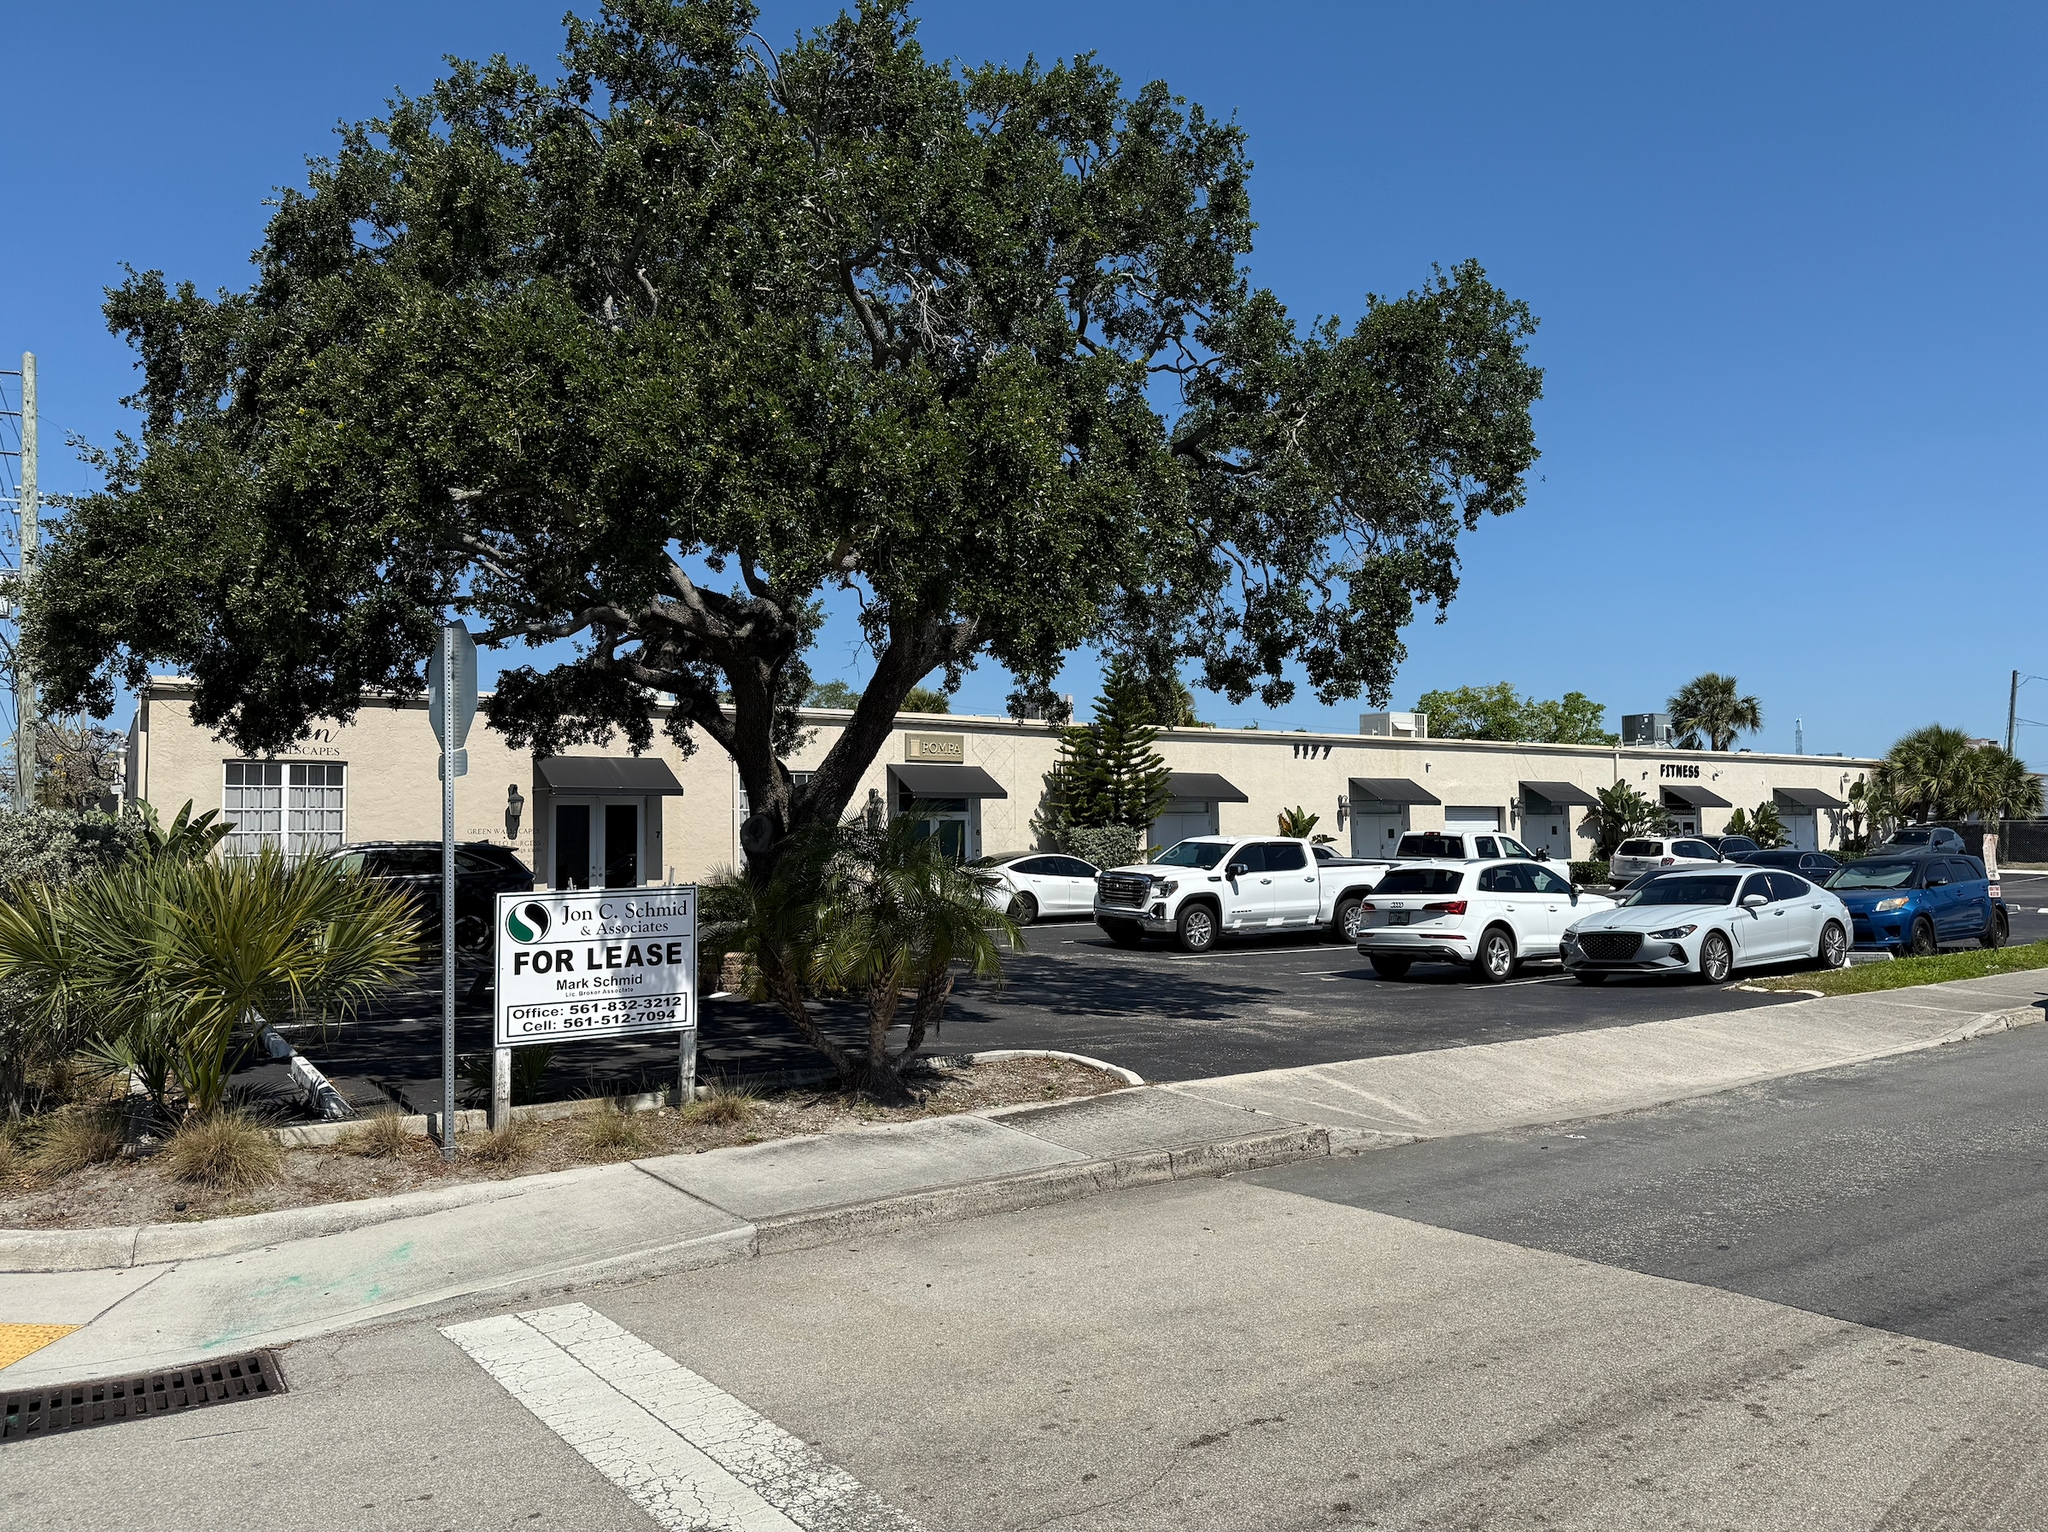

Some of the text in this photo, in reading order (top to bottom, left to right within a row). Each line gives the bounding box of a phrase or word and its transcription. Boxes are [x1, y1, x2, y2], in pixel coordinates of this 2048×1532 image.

[922, 742, 961, 755] POMPA
[1660, 764, 1700, 778] FITNESS
[655, 830, 661, 839] 7
[562, 900, 688, 925] Jon C. Schmid
[580, 921, 669, 936] & Associates
[514, 942, 682, 975] FOR LEASE
[556, 974, 643, 991] Mark Schmid
[513, 996, 682, 1020] Office: 561-832-3212
[522, 1009, 676, 1032] Cell: 561-512-7094
